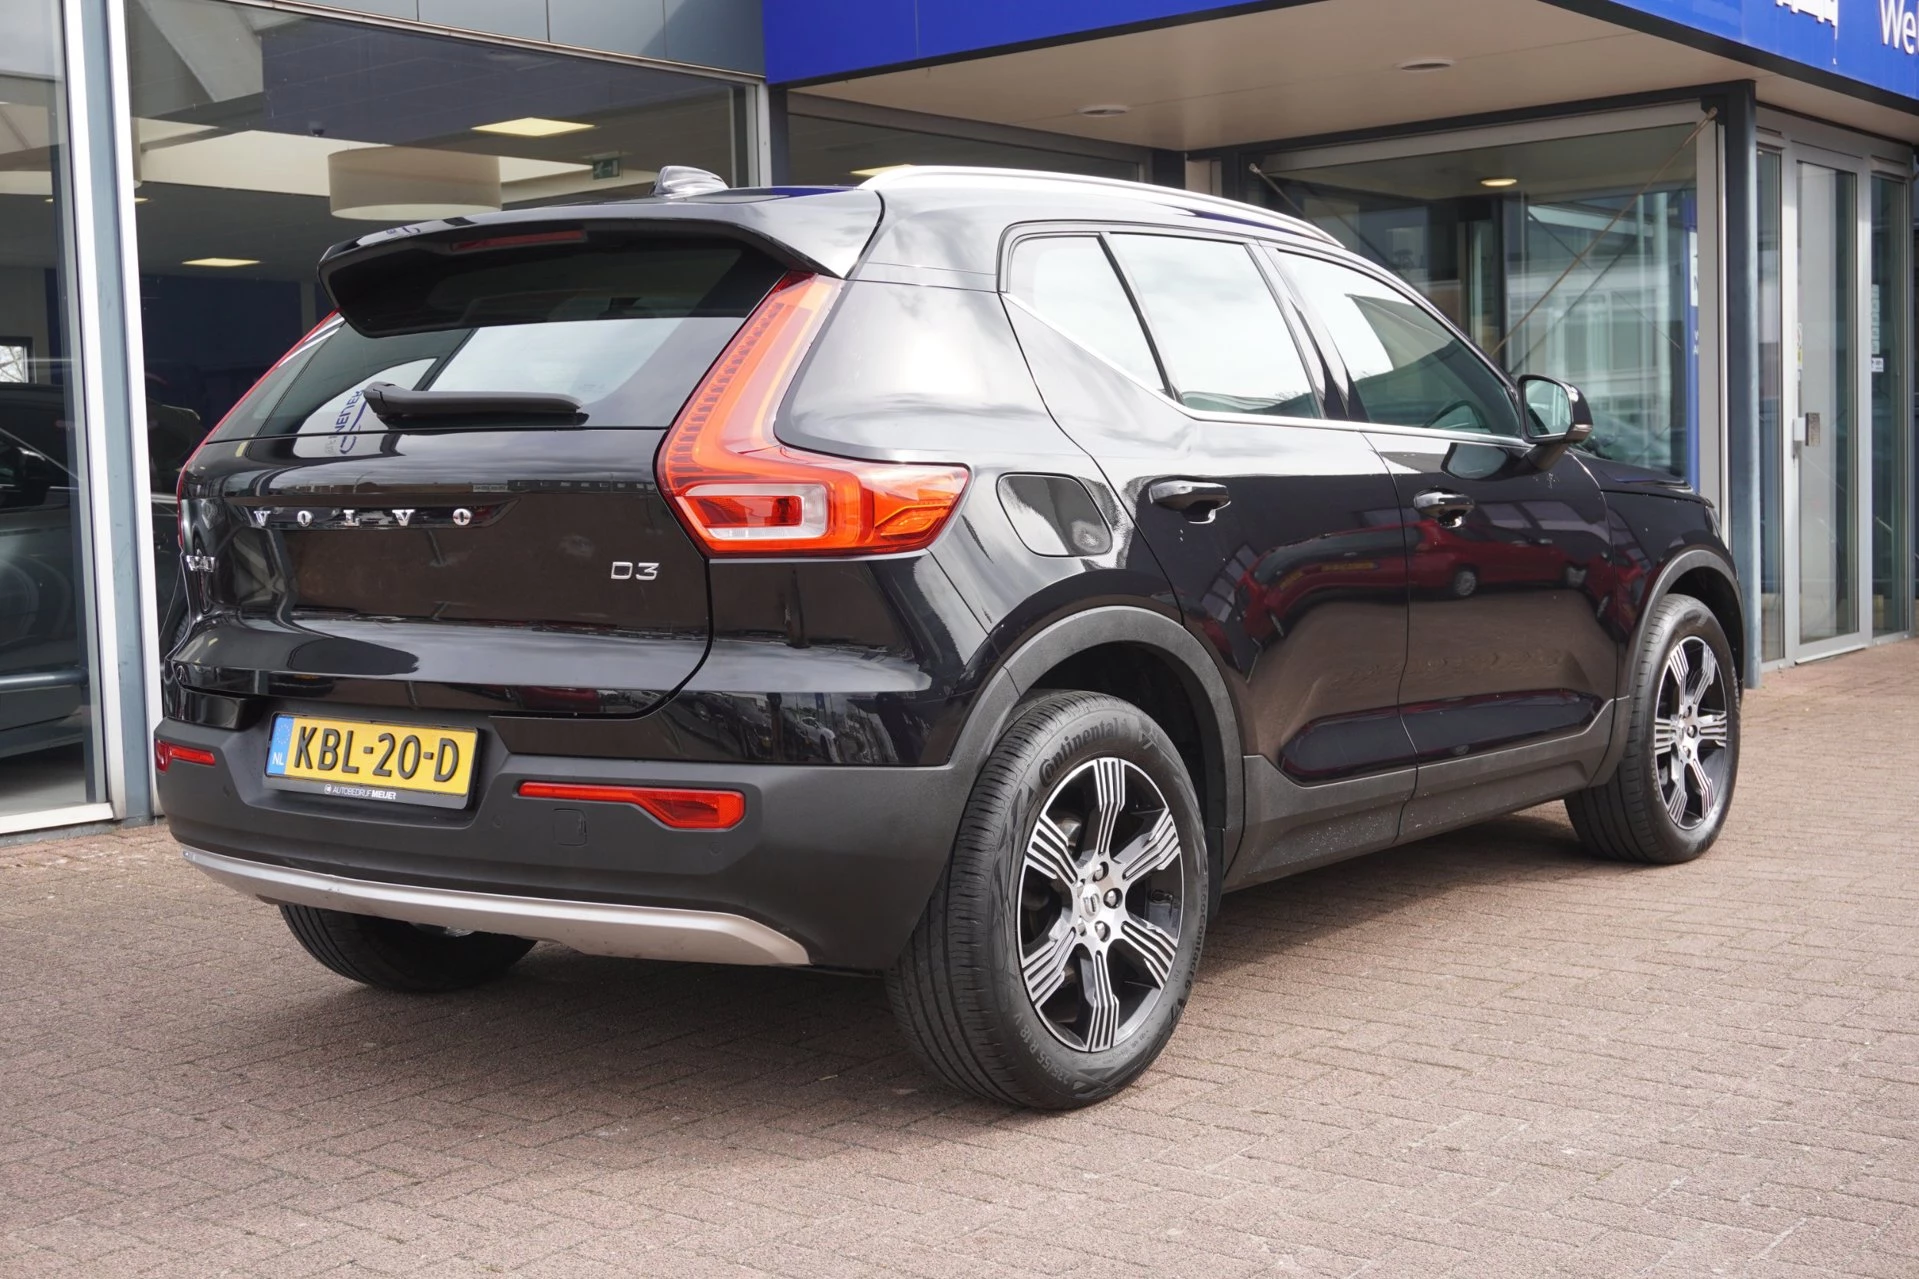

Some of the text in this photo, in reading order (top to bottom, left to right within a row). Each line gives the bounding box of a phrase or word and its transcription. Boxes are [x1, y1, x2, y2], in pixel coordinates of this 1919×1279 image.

[1880, 0, 1919, 55] We
[254, 508, 472, 527] VOLVO
[611, 561, 660, 580] D3
[272, 726, 460, 783] NL KBL-20-D
[1039, 717, 1120, 787] Continental
[333, 786, 397, 800] AUTOBEDRIJF MEIJER
